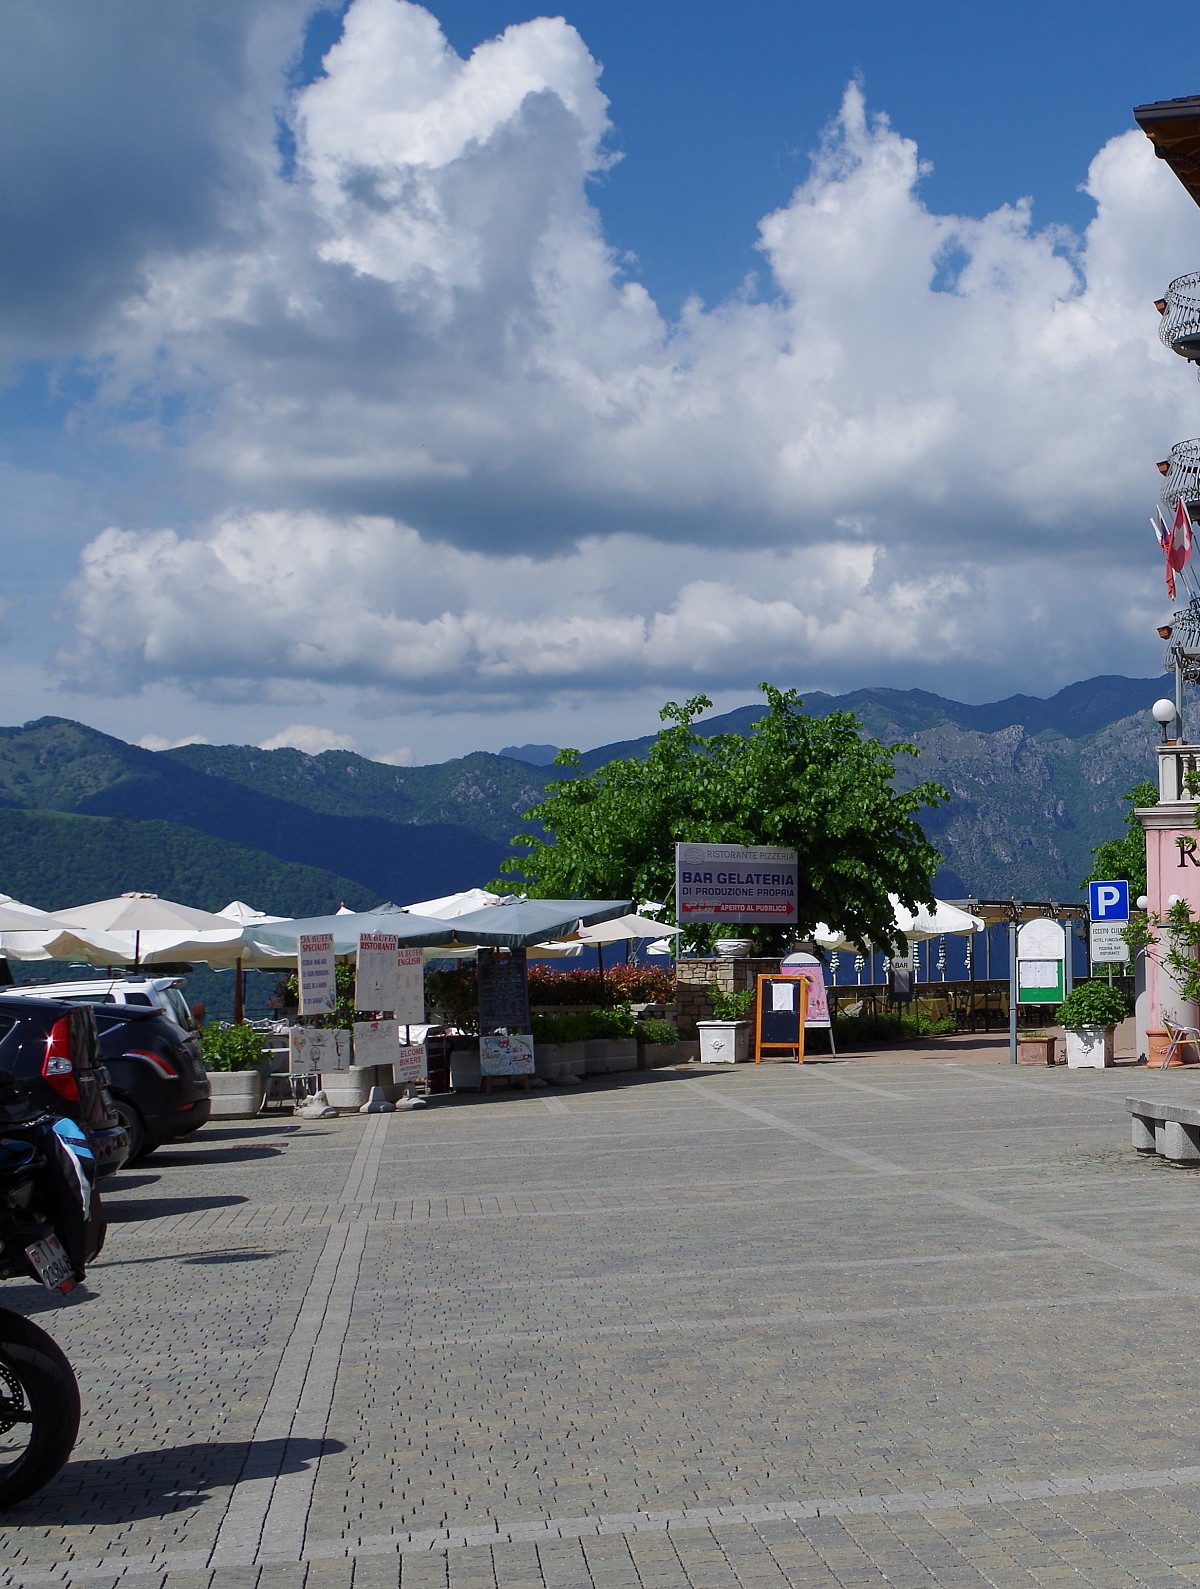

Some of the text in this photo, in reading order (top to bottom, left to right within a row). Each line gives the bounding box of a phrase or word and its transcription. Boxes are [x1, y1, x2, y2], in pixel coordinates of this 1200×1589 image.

[707, 850, 758, 860] RISTORANTE
[760, 851, 794, 861] PIZZERIA
[682, 871, 795, 886] BAR GELATERIA
[682, 887, 795, 897] DI PRODUZIONE PROPRIA
[1098, 886, 1120, 916] P
[360, 933, 397, 942] DA BUFFA
[361, 942, 396, 950] RISTORANTE
[398, 957, 420, 967] ENGLISH
[400, 1047, 423, 1058] ELCOME
[400, 1056, 421, 1066] BIKERS
